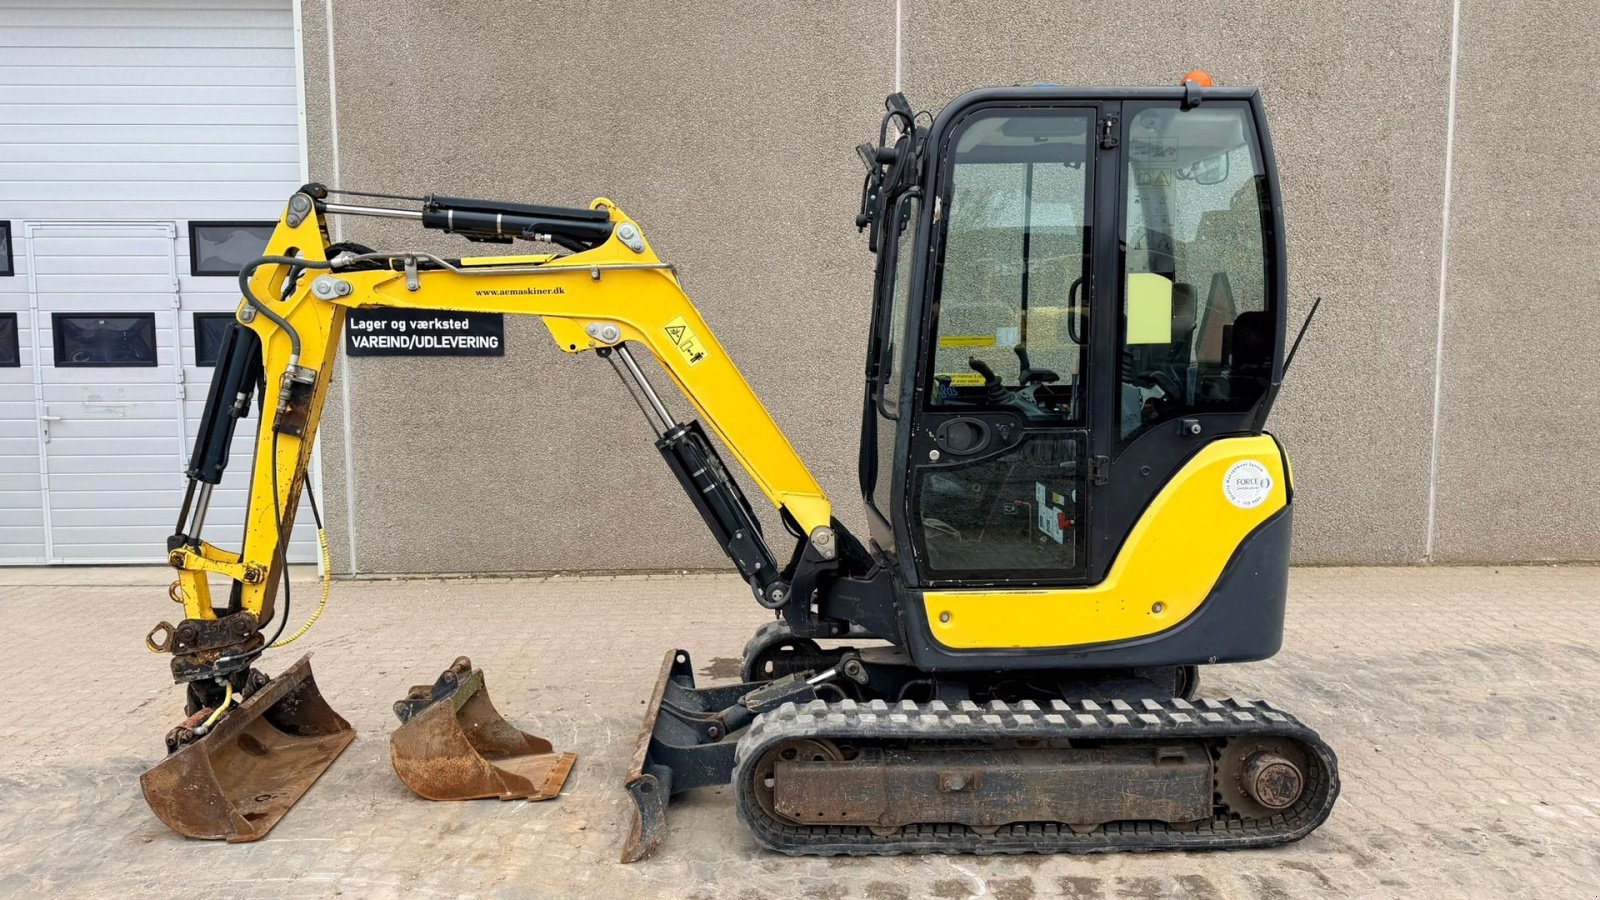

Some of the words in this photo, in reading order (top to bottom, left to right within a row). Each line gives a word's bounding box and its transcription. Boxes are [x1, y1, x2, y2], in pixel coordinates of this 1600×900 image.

[475, 287, 565, 296] www.aemaskiner.dk
[350, 318, 387, 331] Lager
[391, 320, 406, 331] og
[410, 318, 469, 329] værksted
[352, 335, 499, 350] VAREIND/UDLEVERING
[1236, 478, 1259, 486] FORCE
